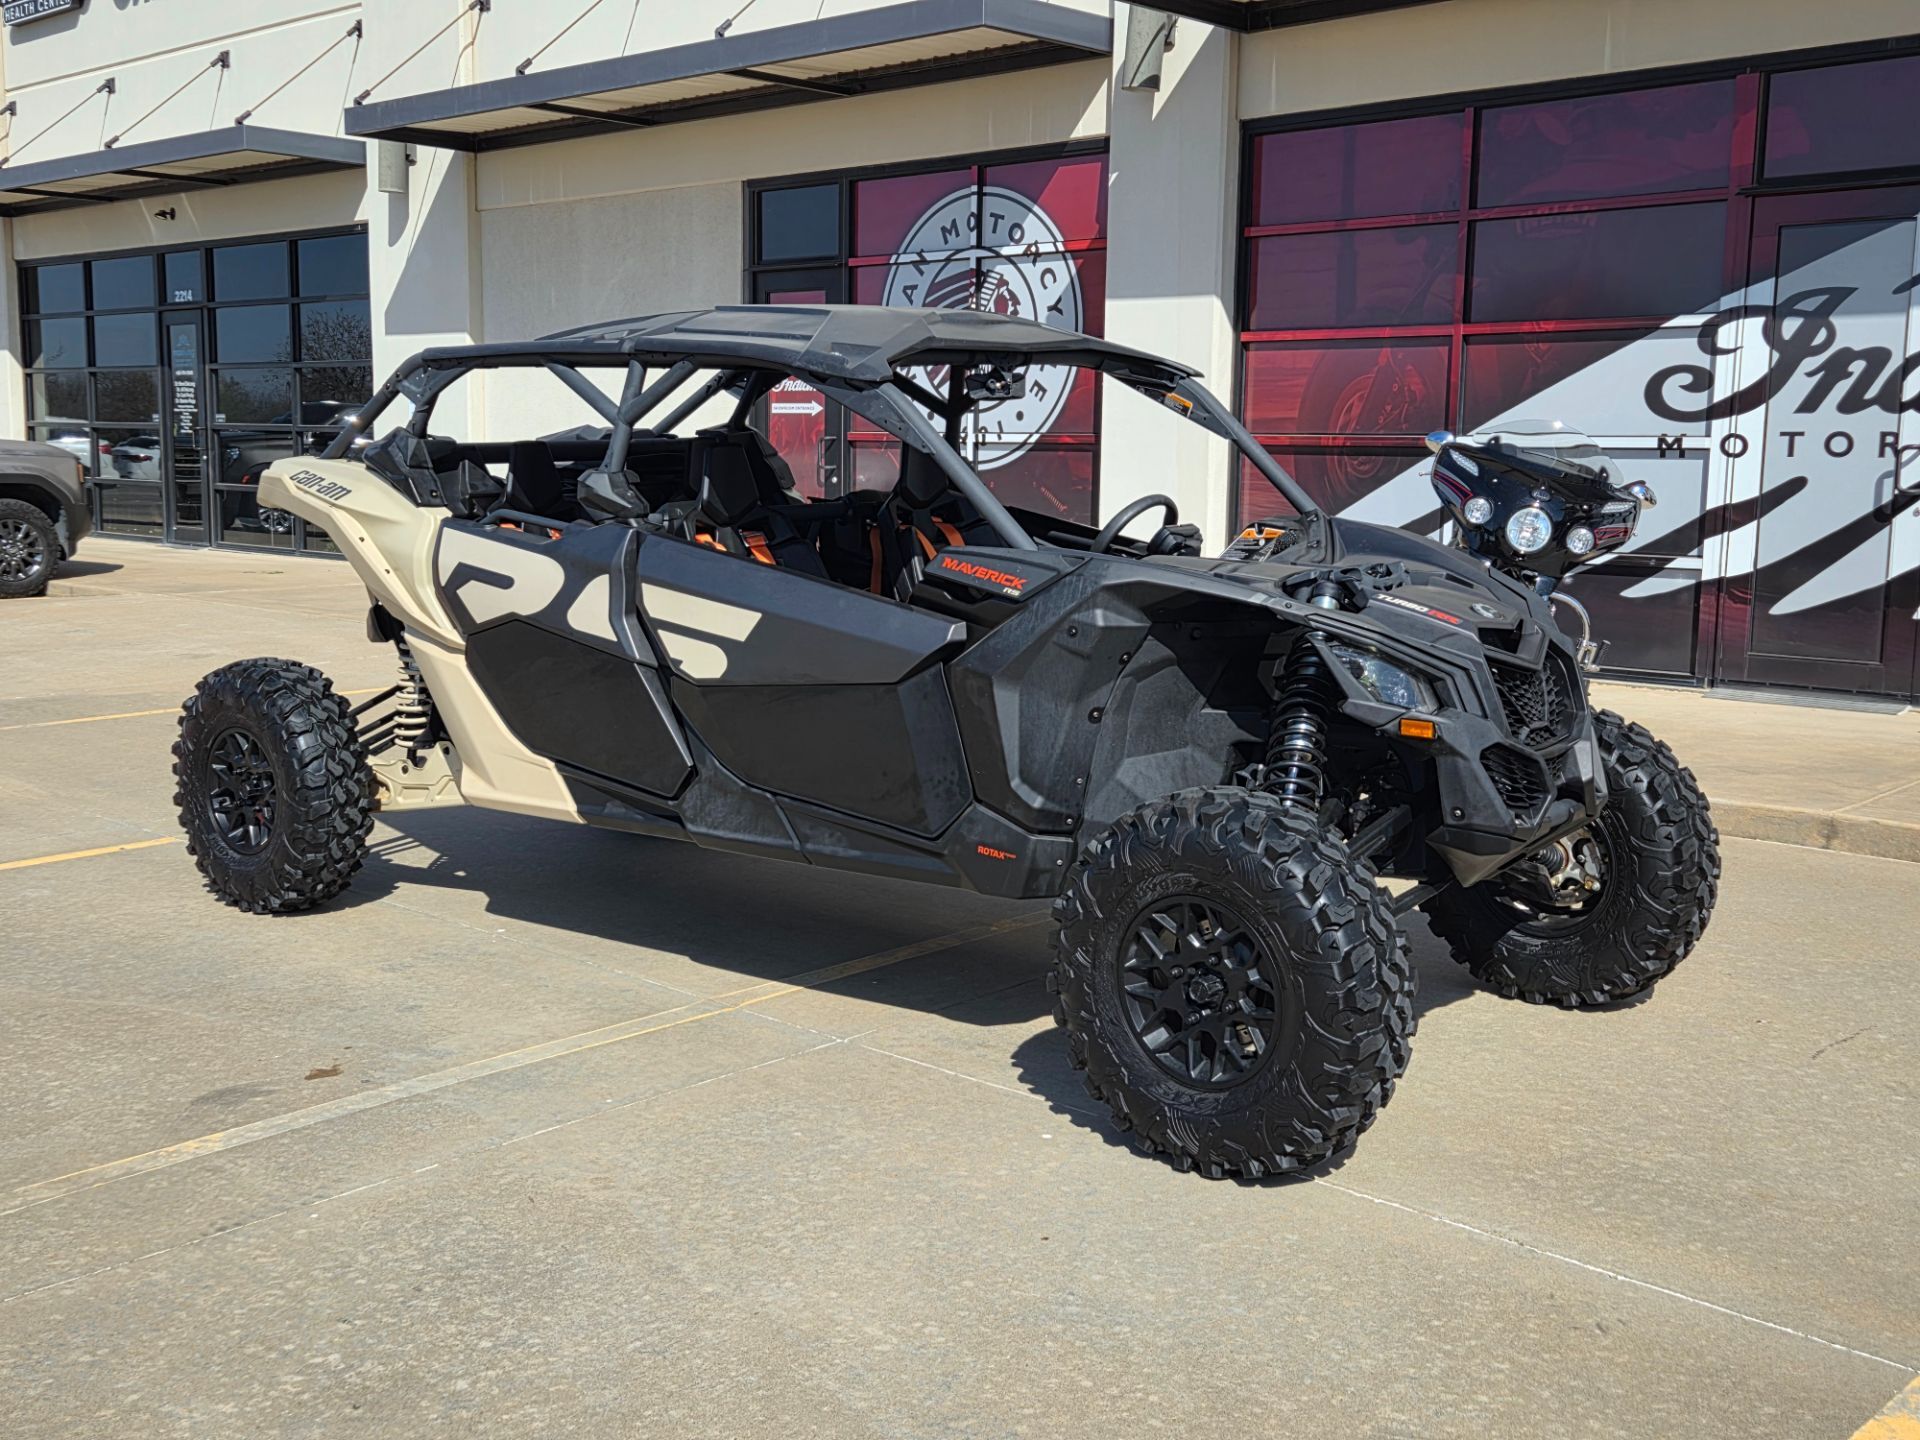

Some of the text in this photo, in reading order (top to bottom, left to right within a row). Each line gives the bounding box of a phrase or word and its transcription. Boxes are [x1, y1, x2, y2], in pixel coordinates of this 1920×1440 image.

[5, 1, 35, 21] HEALTH
[174, 290, 193, 302] 2214
[942, 556, 1027, 590] MAVERICK
[1377, 593, 1429, 613] TURBO
[977, 845, 1004, 860] ROTAX
